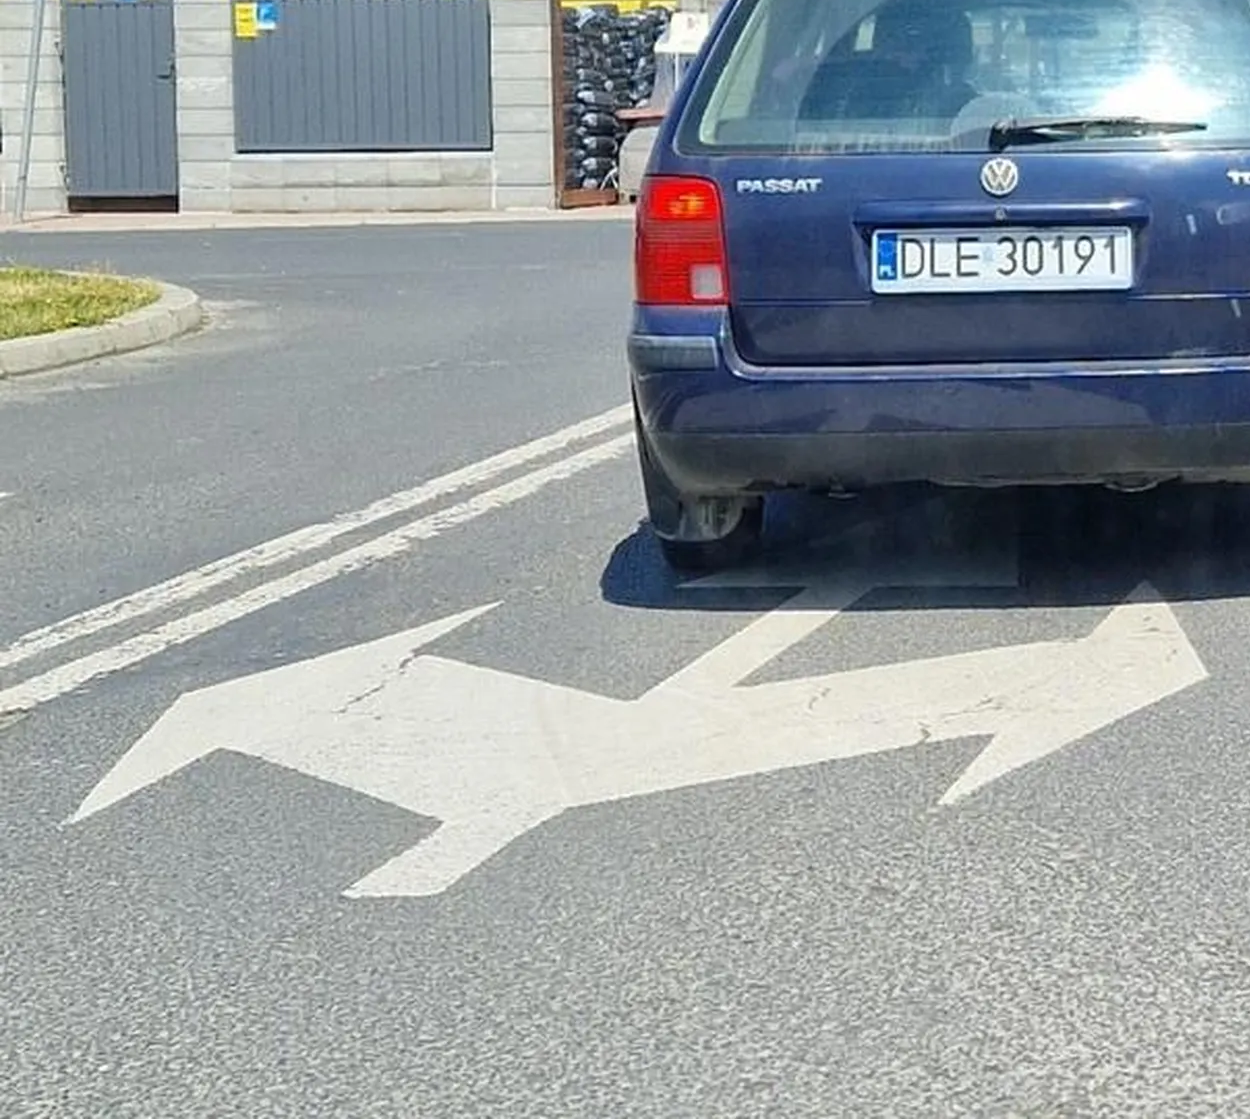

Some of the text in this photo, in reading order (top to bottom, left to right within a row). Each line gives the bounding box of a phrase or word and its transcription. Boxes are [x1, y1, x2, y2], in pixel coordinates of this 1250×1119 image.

[736, 178, 823, 193] PASSAT
[900, 237, 980, 278] DLE
[996, 234, 1117, 276] 30191
